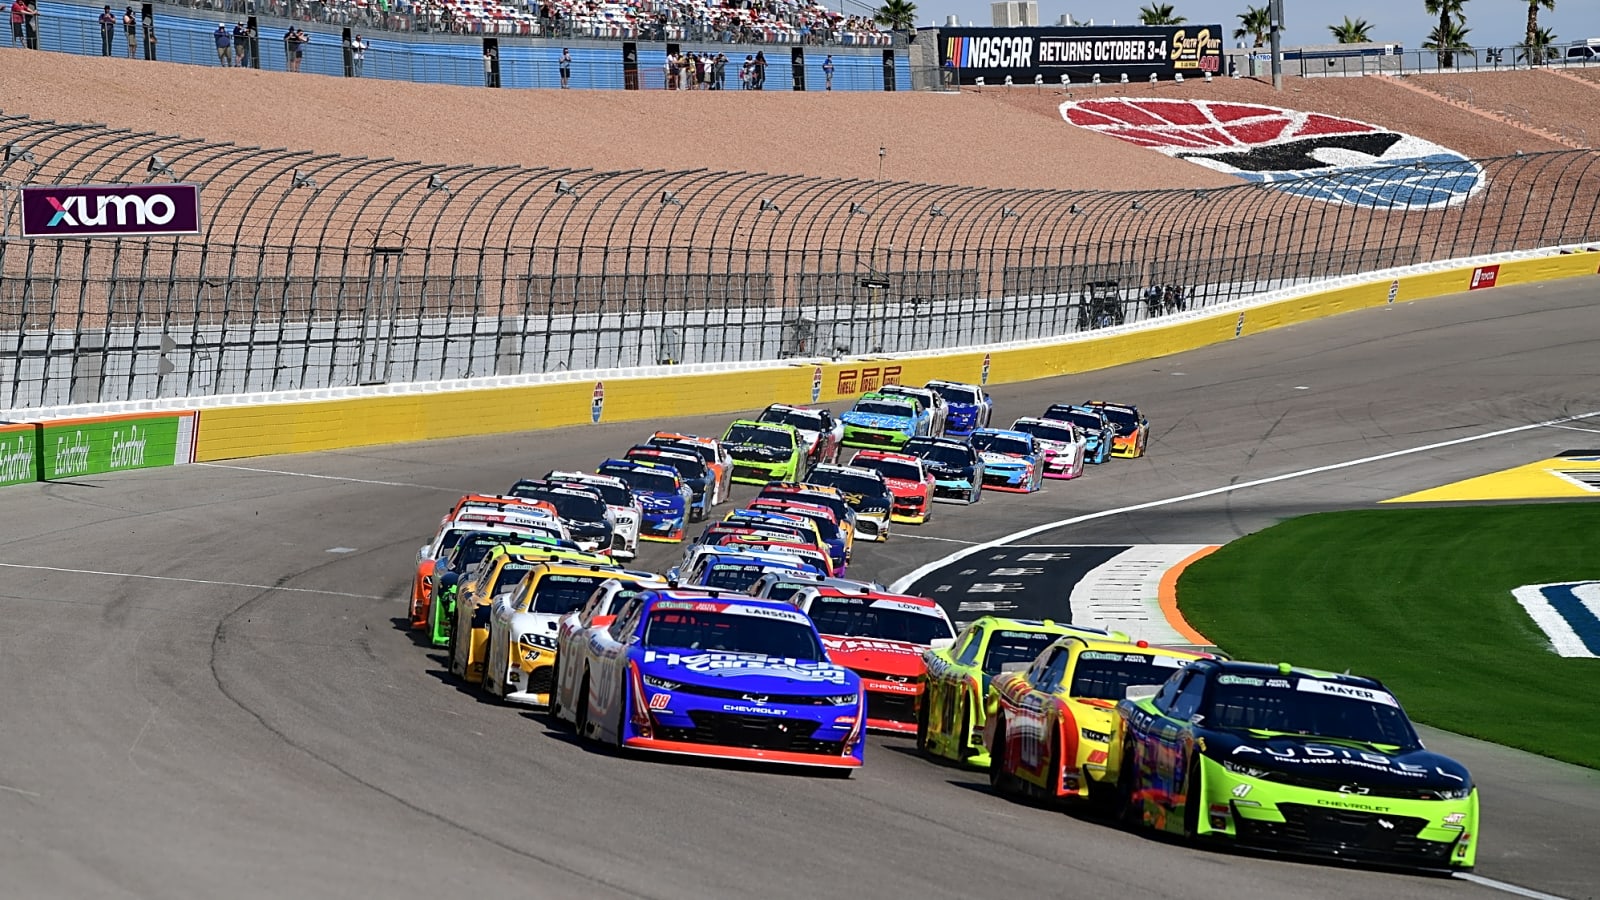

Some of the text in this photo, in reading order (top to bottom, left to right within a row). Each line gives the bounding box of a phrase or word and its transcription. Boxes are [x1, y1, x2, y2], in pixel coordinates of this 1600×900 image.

[967, 36, 1032, 68] NASCAR
[1039, 40, 1167, 62] RETURNS OCTOBER 3-4
[1199, 56, 1220, 72] 400
[46, 193, 176, 226] xumo
[837, 369, 858, 394] PIRELLI
[860, 367, 880, 392] PIRELLI
[55, 430, 91, 475] EchoPark
[110, 424, 147, 468] EchoPark
[515, 518, 547, 527] CUSTER
[786, 548, 817, 557] BURTON
[745, 607, 797, 620] LARSON
[897, 603, 922, 611] LOVE
[1323, 684, 1375, 700] MAYER
[650, 693, 672, 710] 88
[723, 704, 788, 716] CHEVROLET
[1231, 744, 1464, 783] AUDIBEL
[1231, 783, 1253, 799] 41
[1317, 799, 1392, 813] CHEVROLET
